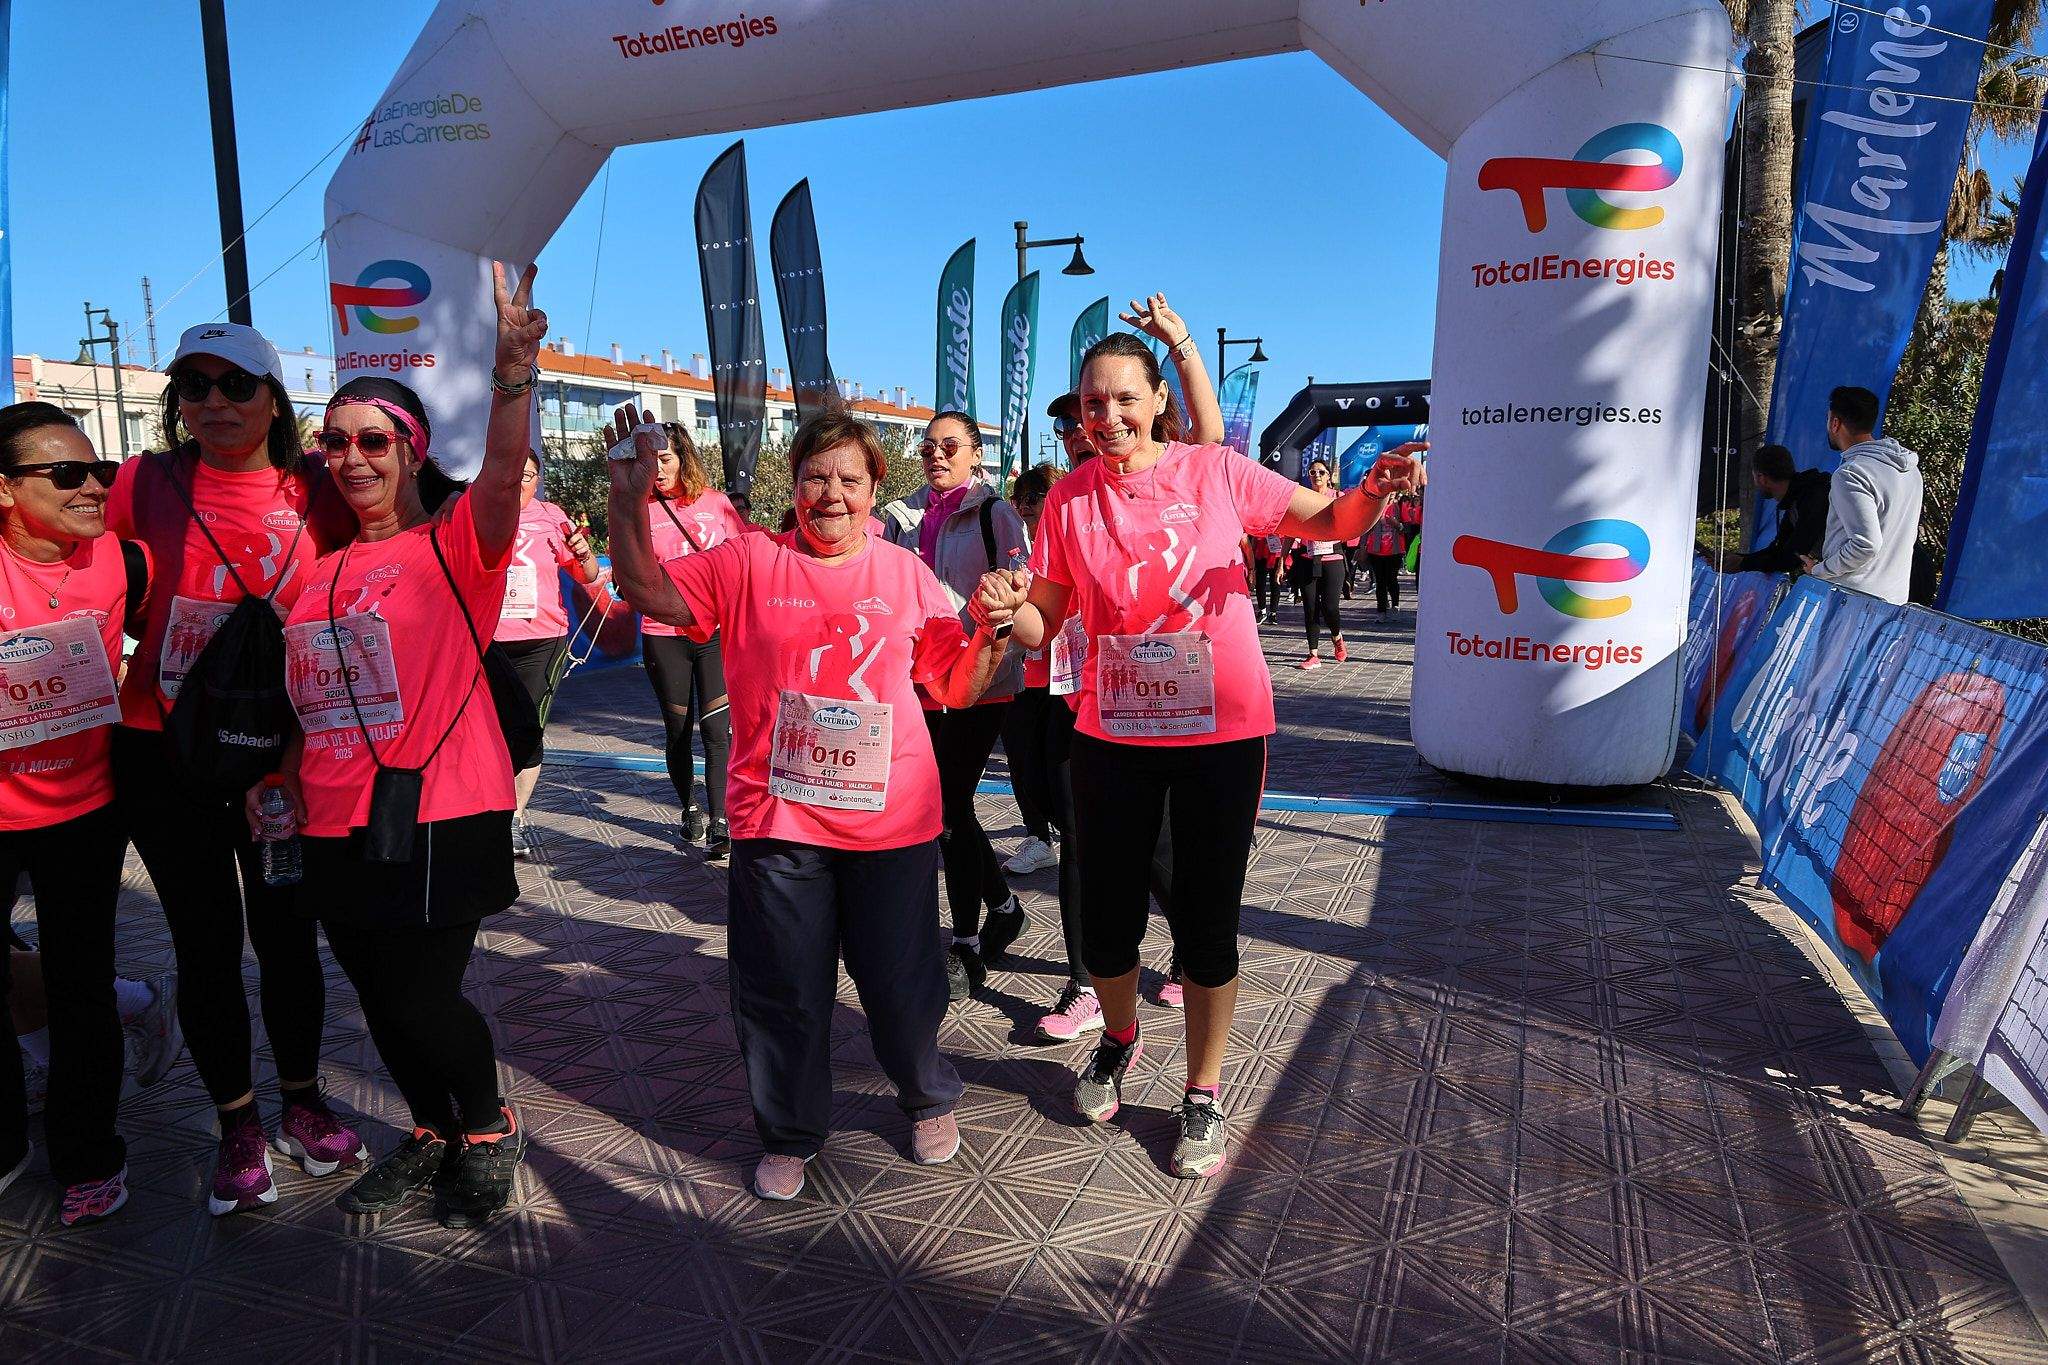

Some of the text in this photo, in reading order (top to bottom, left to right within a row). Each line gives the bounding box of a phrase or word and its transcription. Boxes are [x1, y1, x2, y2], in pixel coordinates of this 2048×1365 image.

[613, 13, 778, 59] TotalEnergies
[374, 123, 491, 148] LasCarreras
[1471, 252, 1676, 288] TotalEnergies
[1461, 402, 1662, 427] totalenergies.es
[1133, 650, 1173, 659] ASTURIANA
[1446, 631, 1644, 671] TotalEnergies
[316, 665, 361, 687] 016
[8, 675, 67, 701] 016
[325, 689, 346, 699] 9204
[1135, 680, 1178, 697] 016
[27, 701, 53, 713] 4465
[40, 709, 63, 720] MUJER
[67, 700, 99, 714] VALENCIA
[1147, 701, 1163, 709] 415
[62, 713, 104, 729] Santander
[816, 712, 858, 726] ASTURIANA
[1112, 721, 1203, 731] OYSHO Santander
[346, 731, 361, 745] LA
[334, 747, 353, 760] 2025
[811, 746, 857, 767] 016
[820, 769, 838, 778] 417
[807, 776, 815, 784] DE
[816, 777, 824, 785] LA
[825, 779, 844, 788] MUJER
[781, 783, 873, 804] OYSHO Santander
